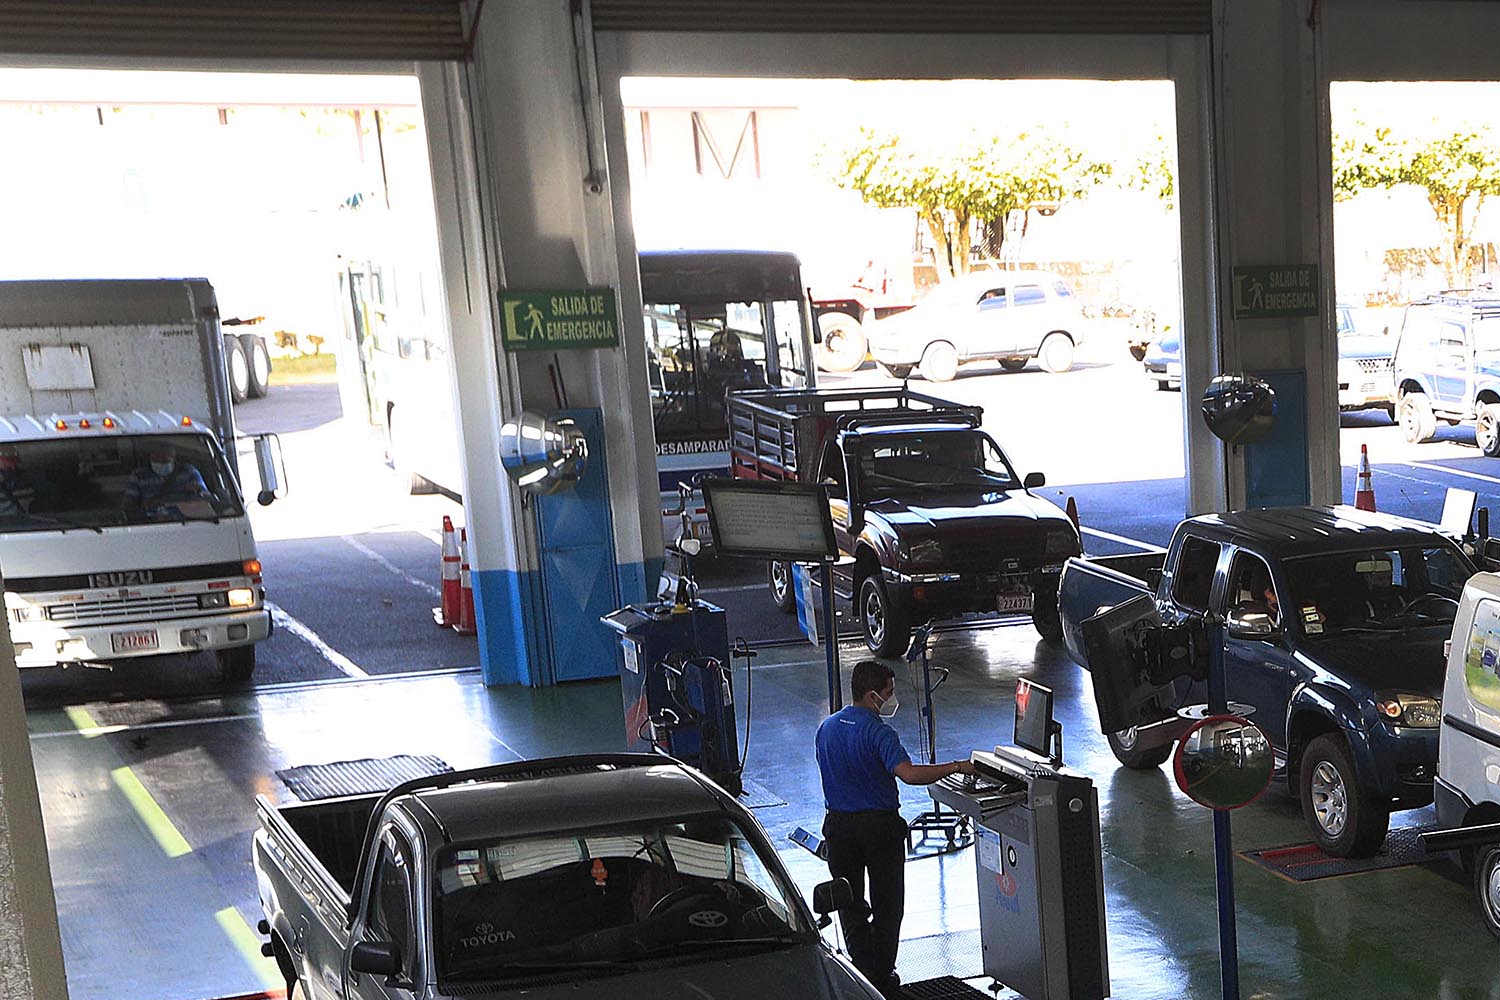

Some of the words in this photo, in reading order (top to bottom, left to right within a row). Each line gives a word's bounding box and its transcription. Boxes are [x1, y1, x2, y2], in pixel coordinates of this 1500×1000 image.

[1269, 270, 1297, 288] SALIDA
[1299, 270, 1310, 288] DE
[551, 296, 589, 316] SALIDA
[590, 296, 605, 314] DE
[1265, 292, 1316, 309] EMERGENCIA
[546, 320, 614, 341] EMERGENCIA
[88, 569, 153, 588] ISUZU
[460, 930, 516, 948] TOYOTA
